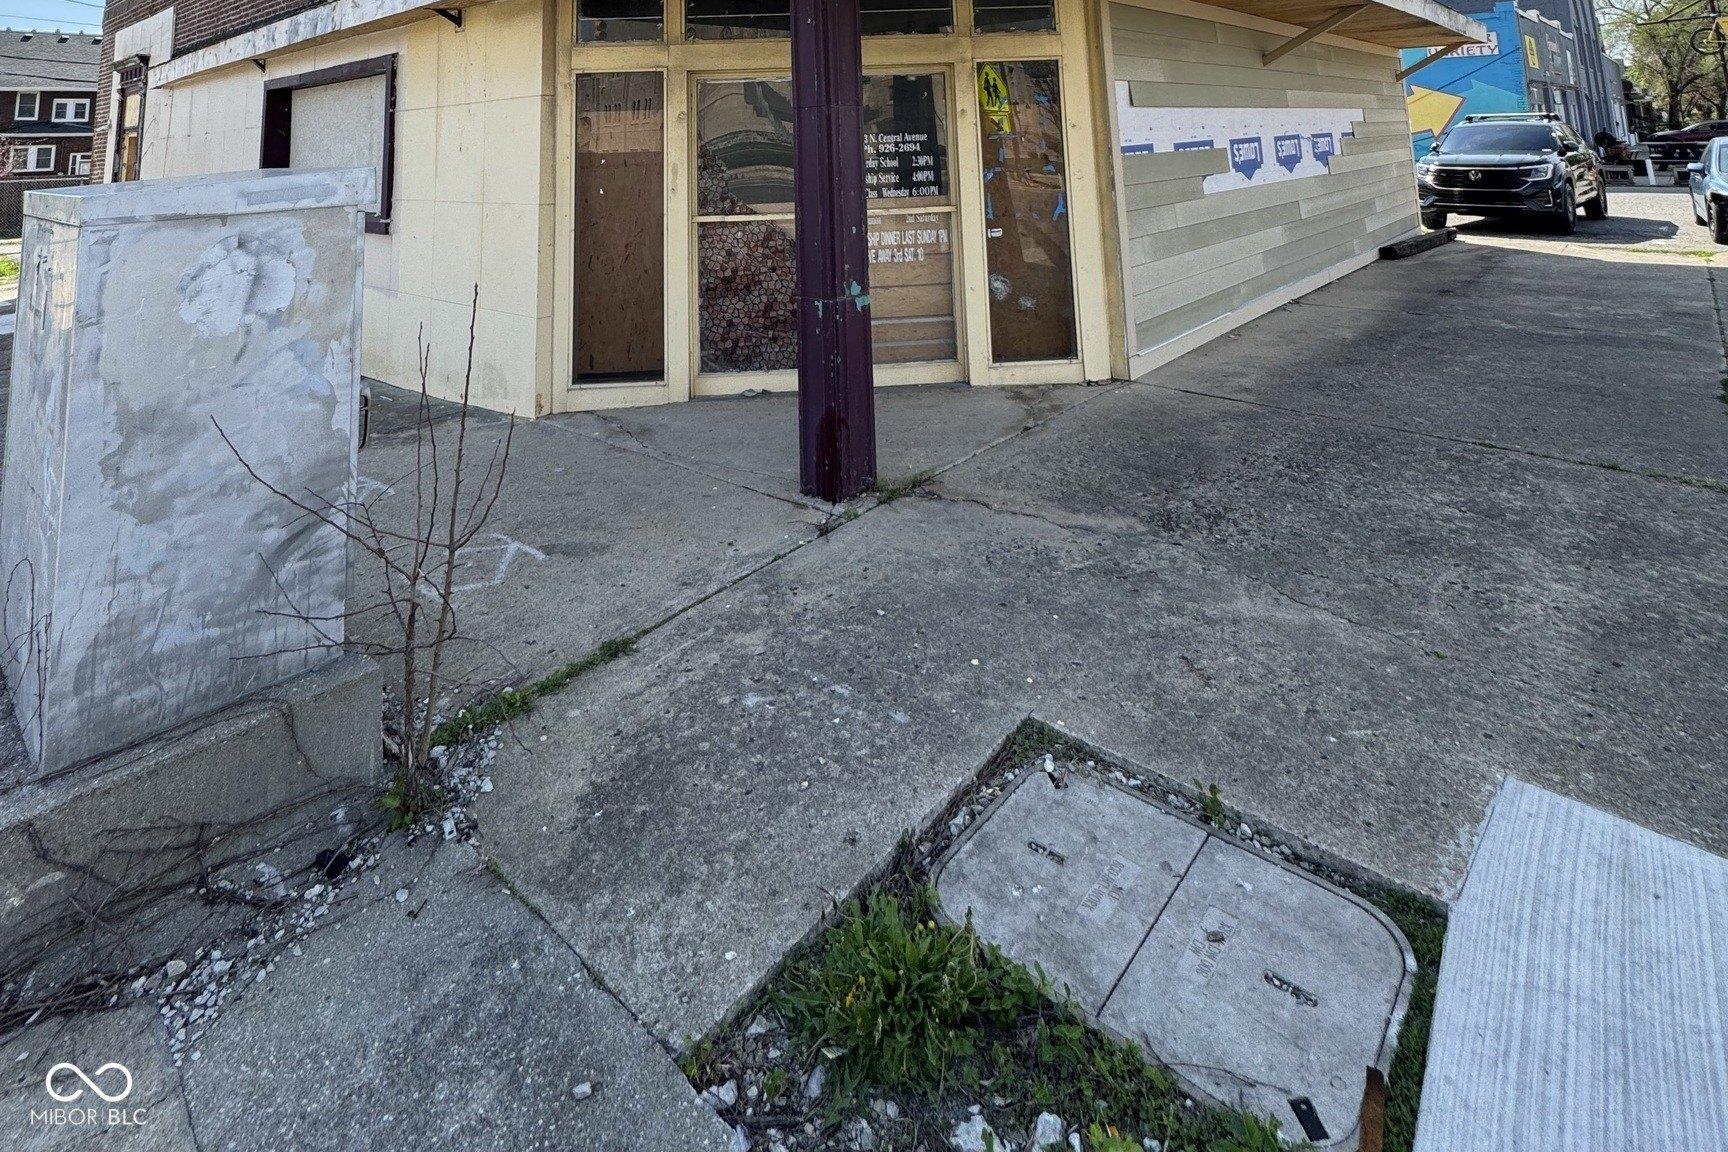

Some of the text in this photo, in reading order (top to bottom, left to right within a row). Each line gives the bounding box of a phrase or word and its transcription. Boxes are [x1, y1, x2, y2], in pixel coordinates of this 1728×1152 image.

[1428, 44, 1498, 56] VRIETY
[870, 134, 877, 143] N.
[878, 132, 902, 143] Central
[903, 133, 928, 141] Avenue
[879, 143, 921, 153] 926-2694
[880, 156, 899, 168] School
[879, 172, 899, 183] Service
[882, 187, 910, 199] Wednesday
[912, 186, 939, 196] 6:00PM
[916, 213, 939, 223] Saturday
[881, 230, 900, 245] DINNER
[901, 230, 915, 245] LAST
[916, 229, 937, 244] SUNDAY
